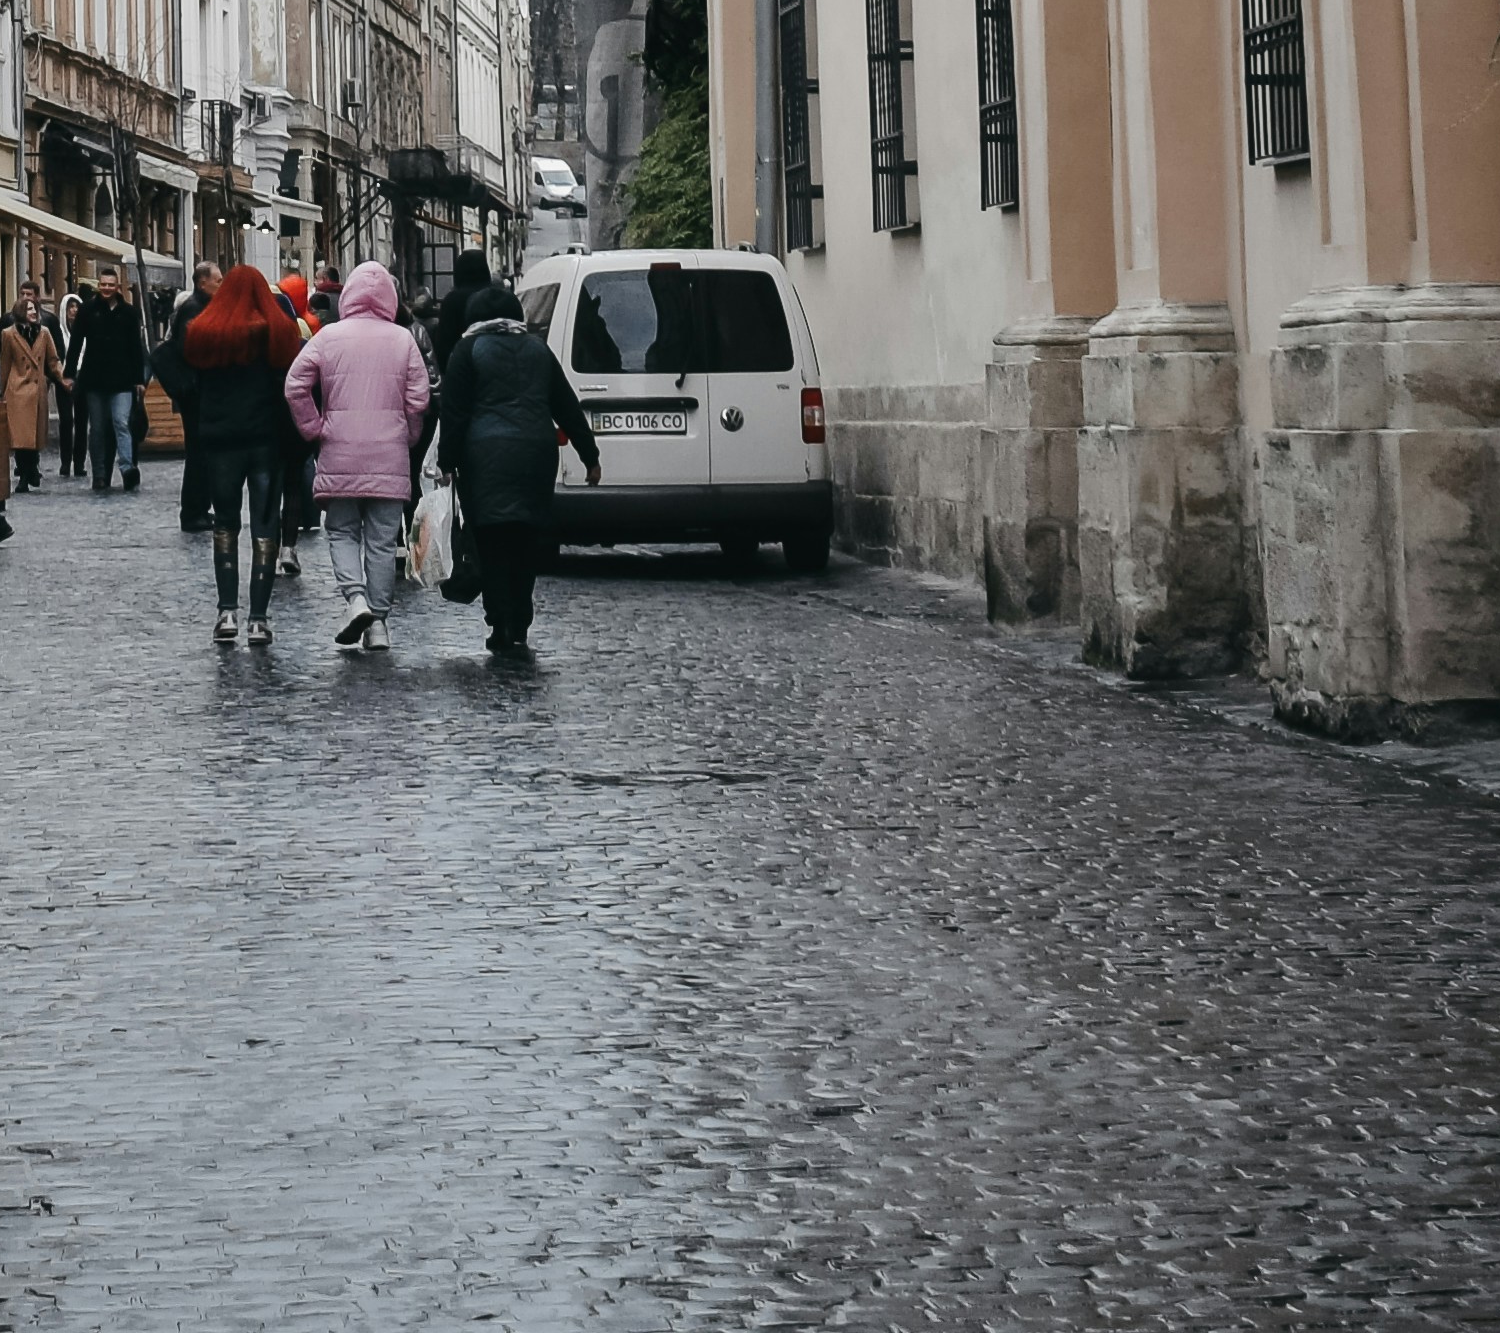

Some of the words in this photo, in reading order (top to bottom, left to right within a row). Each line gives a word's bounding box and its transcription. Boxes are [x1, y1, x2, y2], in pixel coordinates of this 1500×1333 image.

[602, 414, 623, 429] BC
[625, 414, 658, 429] 0106
[661, 414, 683, 429] CO
